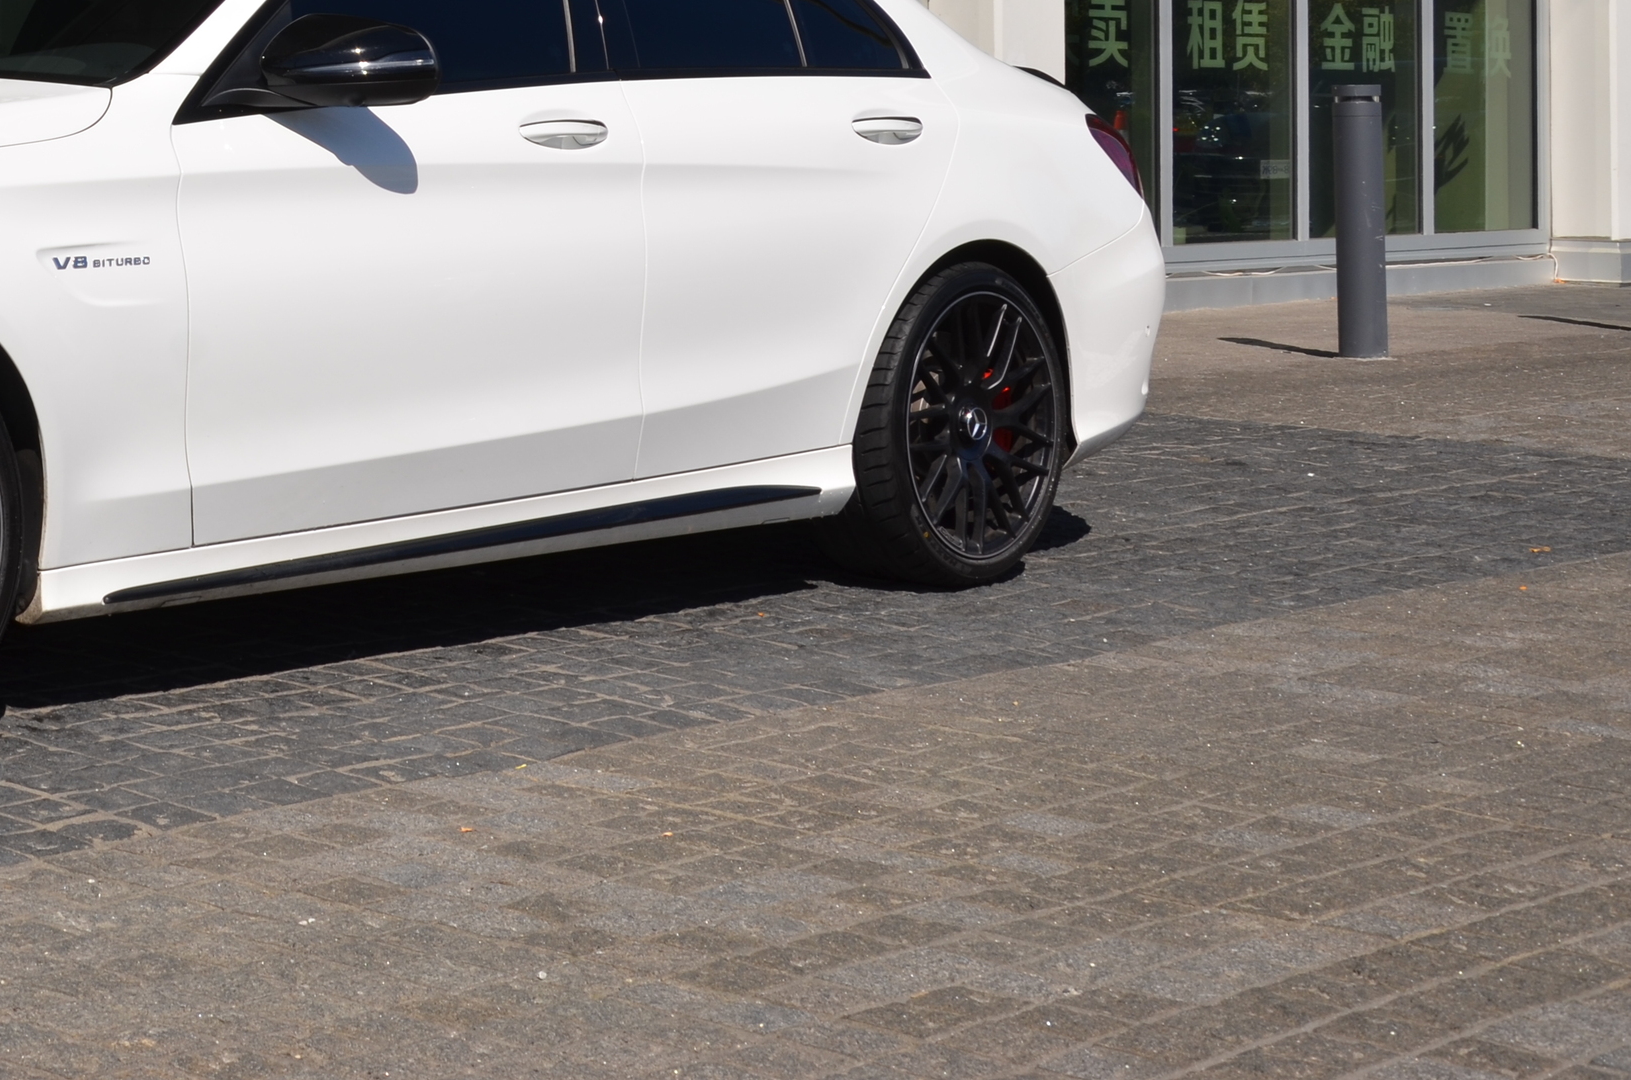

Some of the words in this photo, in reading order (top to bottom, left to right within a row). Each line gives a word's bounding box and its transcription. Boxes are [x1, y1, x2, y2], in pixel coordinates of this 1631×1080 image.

[1320, 3, 1395, 73] 金融
[1444, 11, 1512, 78] 置换
[52, 256, 88, 270] V8
[92, 256, 151, 268] BITURBO
